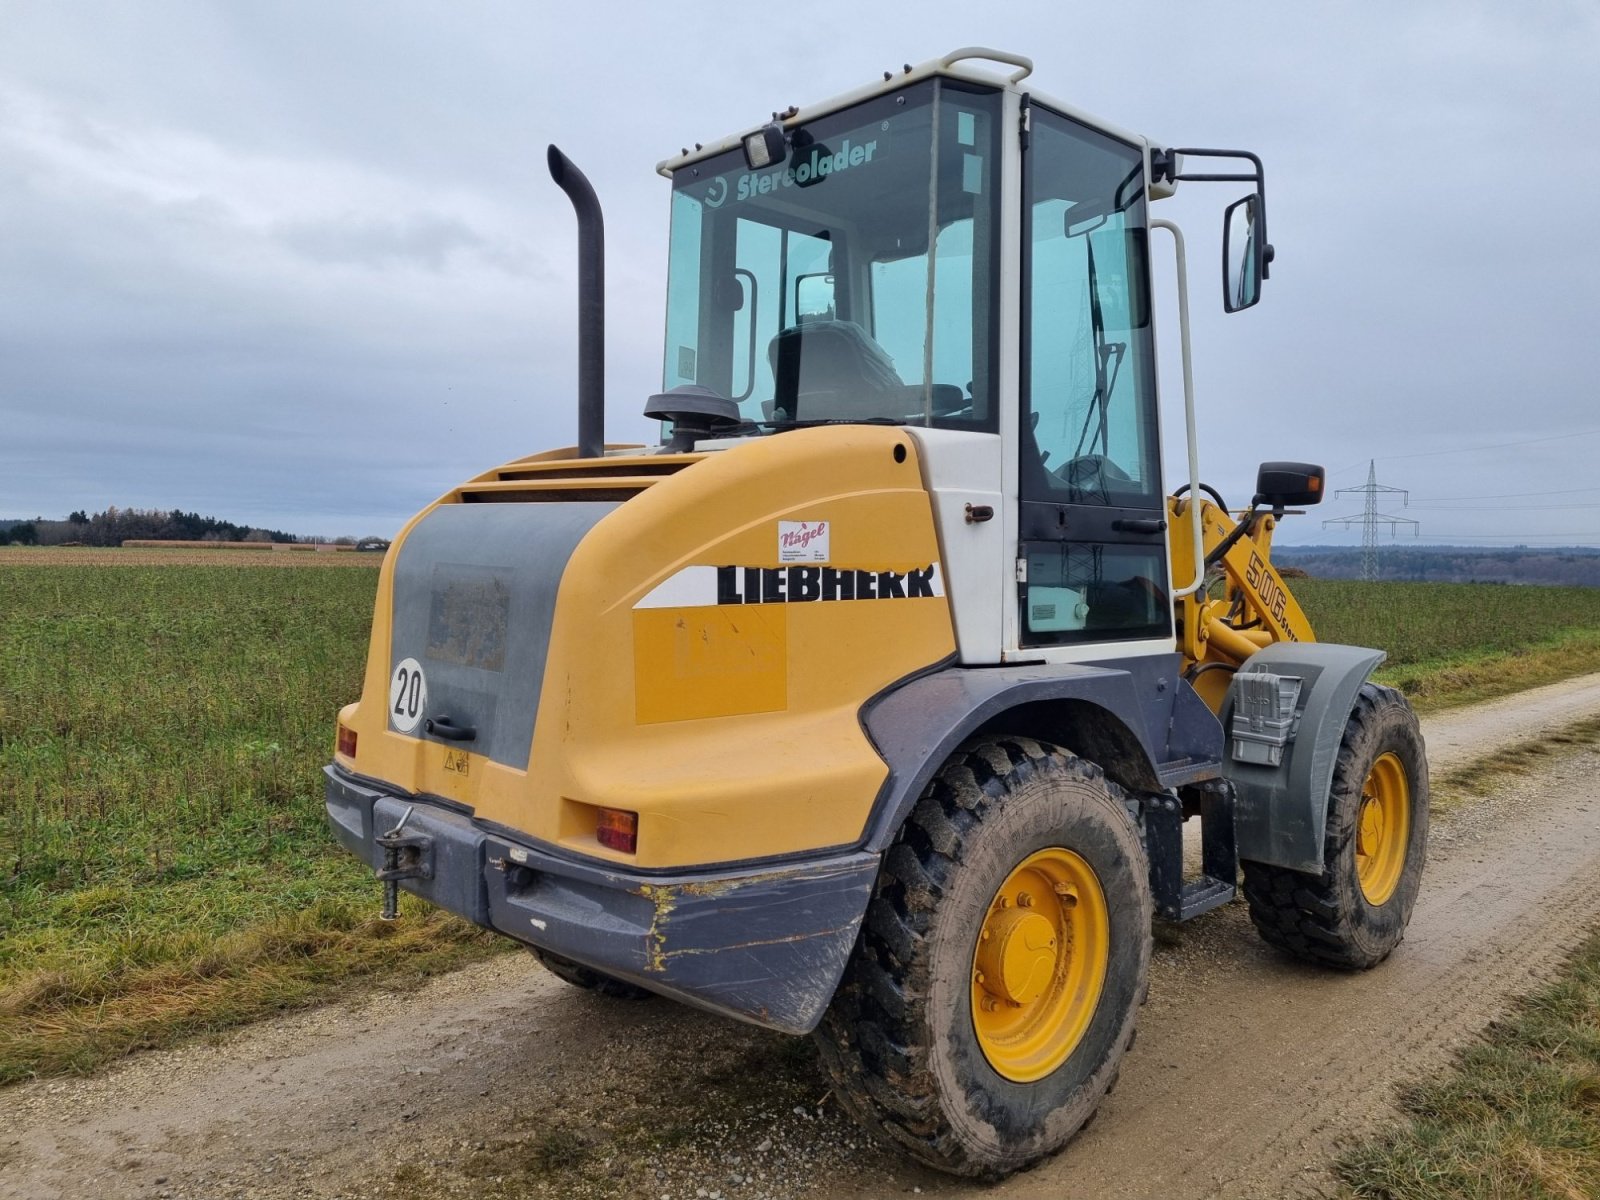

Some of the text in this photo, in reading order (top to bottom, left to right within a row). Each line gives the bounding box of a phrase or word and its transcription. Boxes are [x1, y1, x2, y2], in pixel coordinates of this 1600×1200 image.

[737, 139, 877, 201] Stereolader
[1245, 550, 1287, 623] 506
[394, 667, 421, 718] 20
